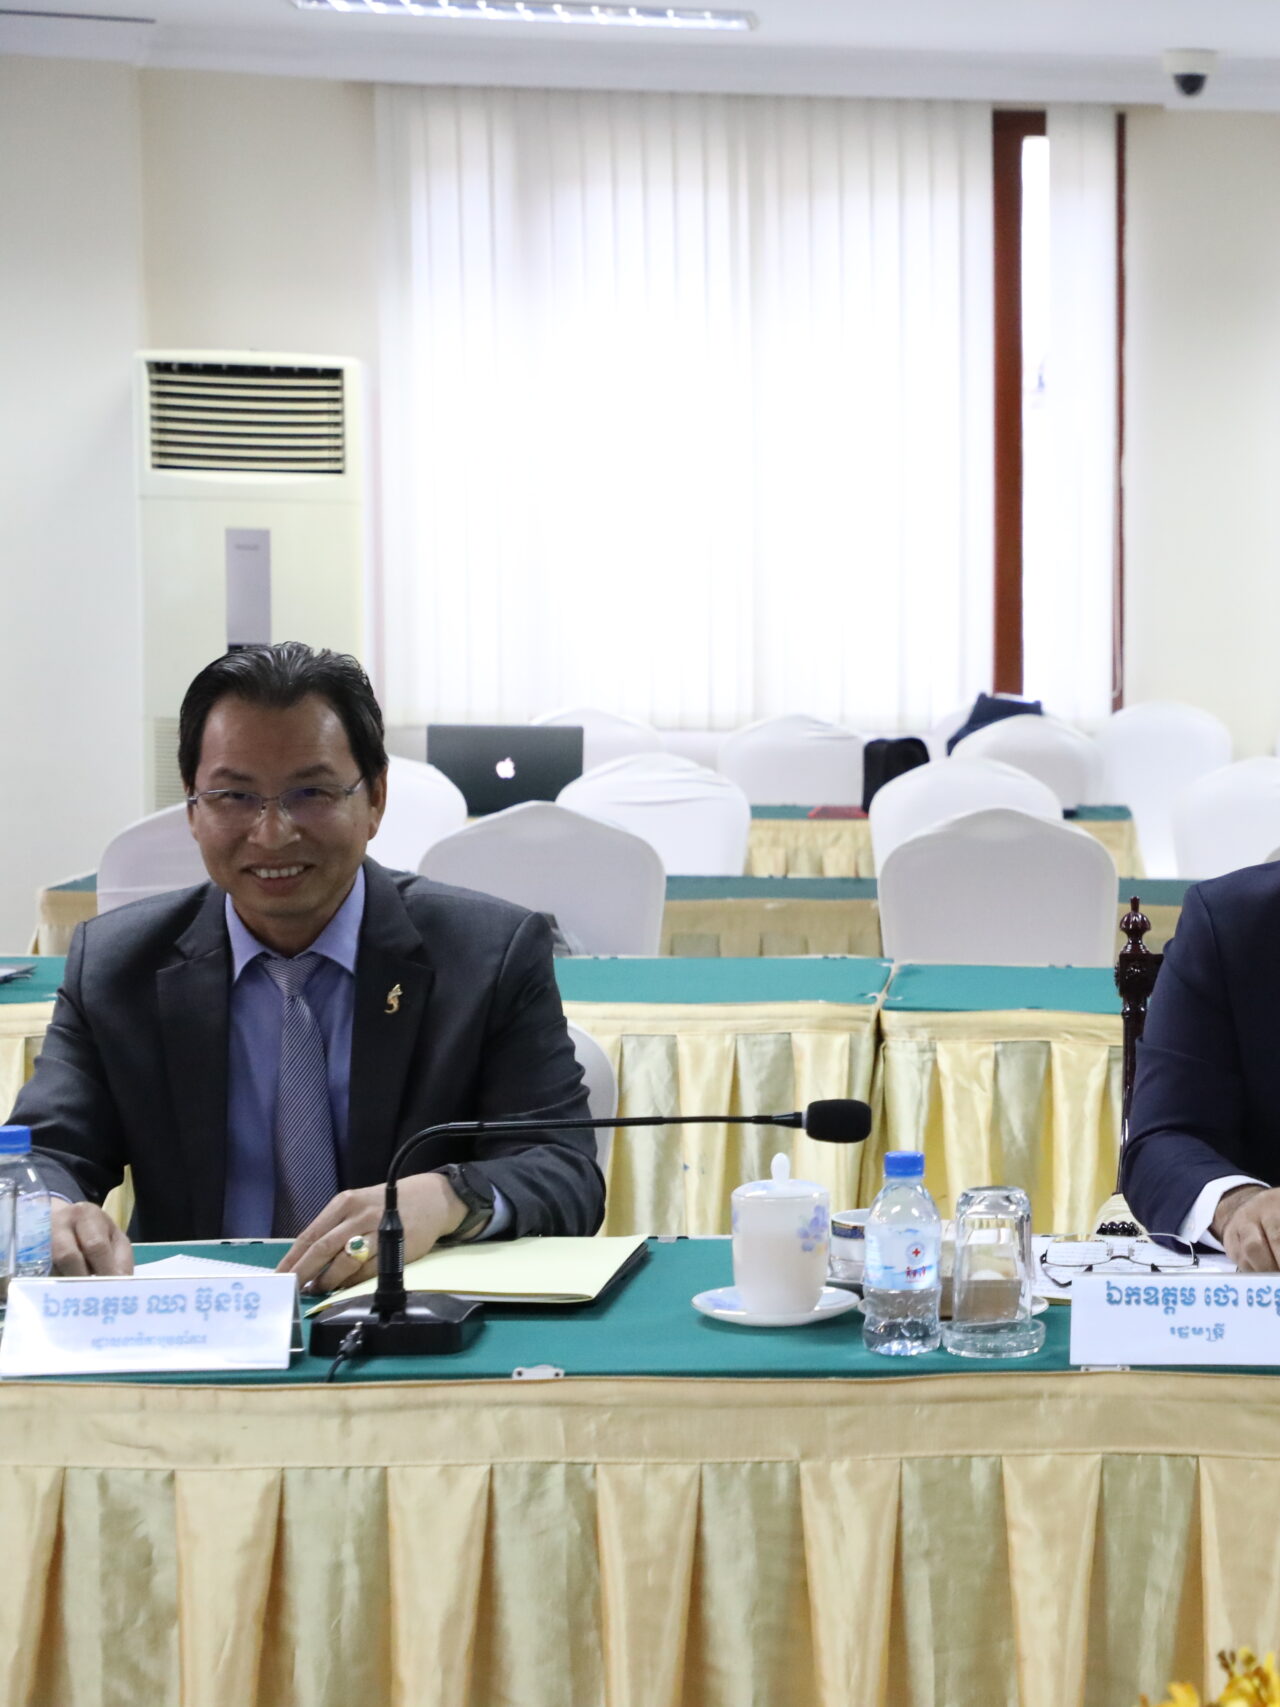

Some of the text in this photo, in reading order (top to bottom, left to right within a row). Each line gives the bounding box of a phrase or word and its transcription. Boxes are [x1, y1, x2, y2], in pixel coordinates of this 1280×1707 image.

[42, 1293, 139, 1325] ឯកឧត្តម
[1105, 1280, 1196, 1315] ឯកឧត្តម
[1204, 1284, 1239, 1307] ថោ
